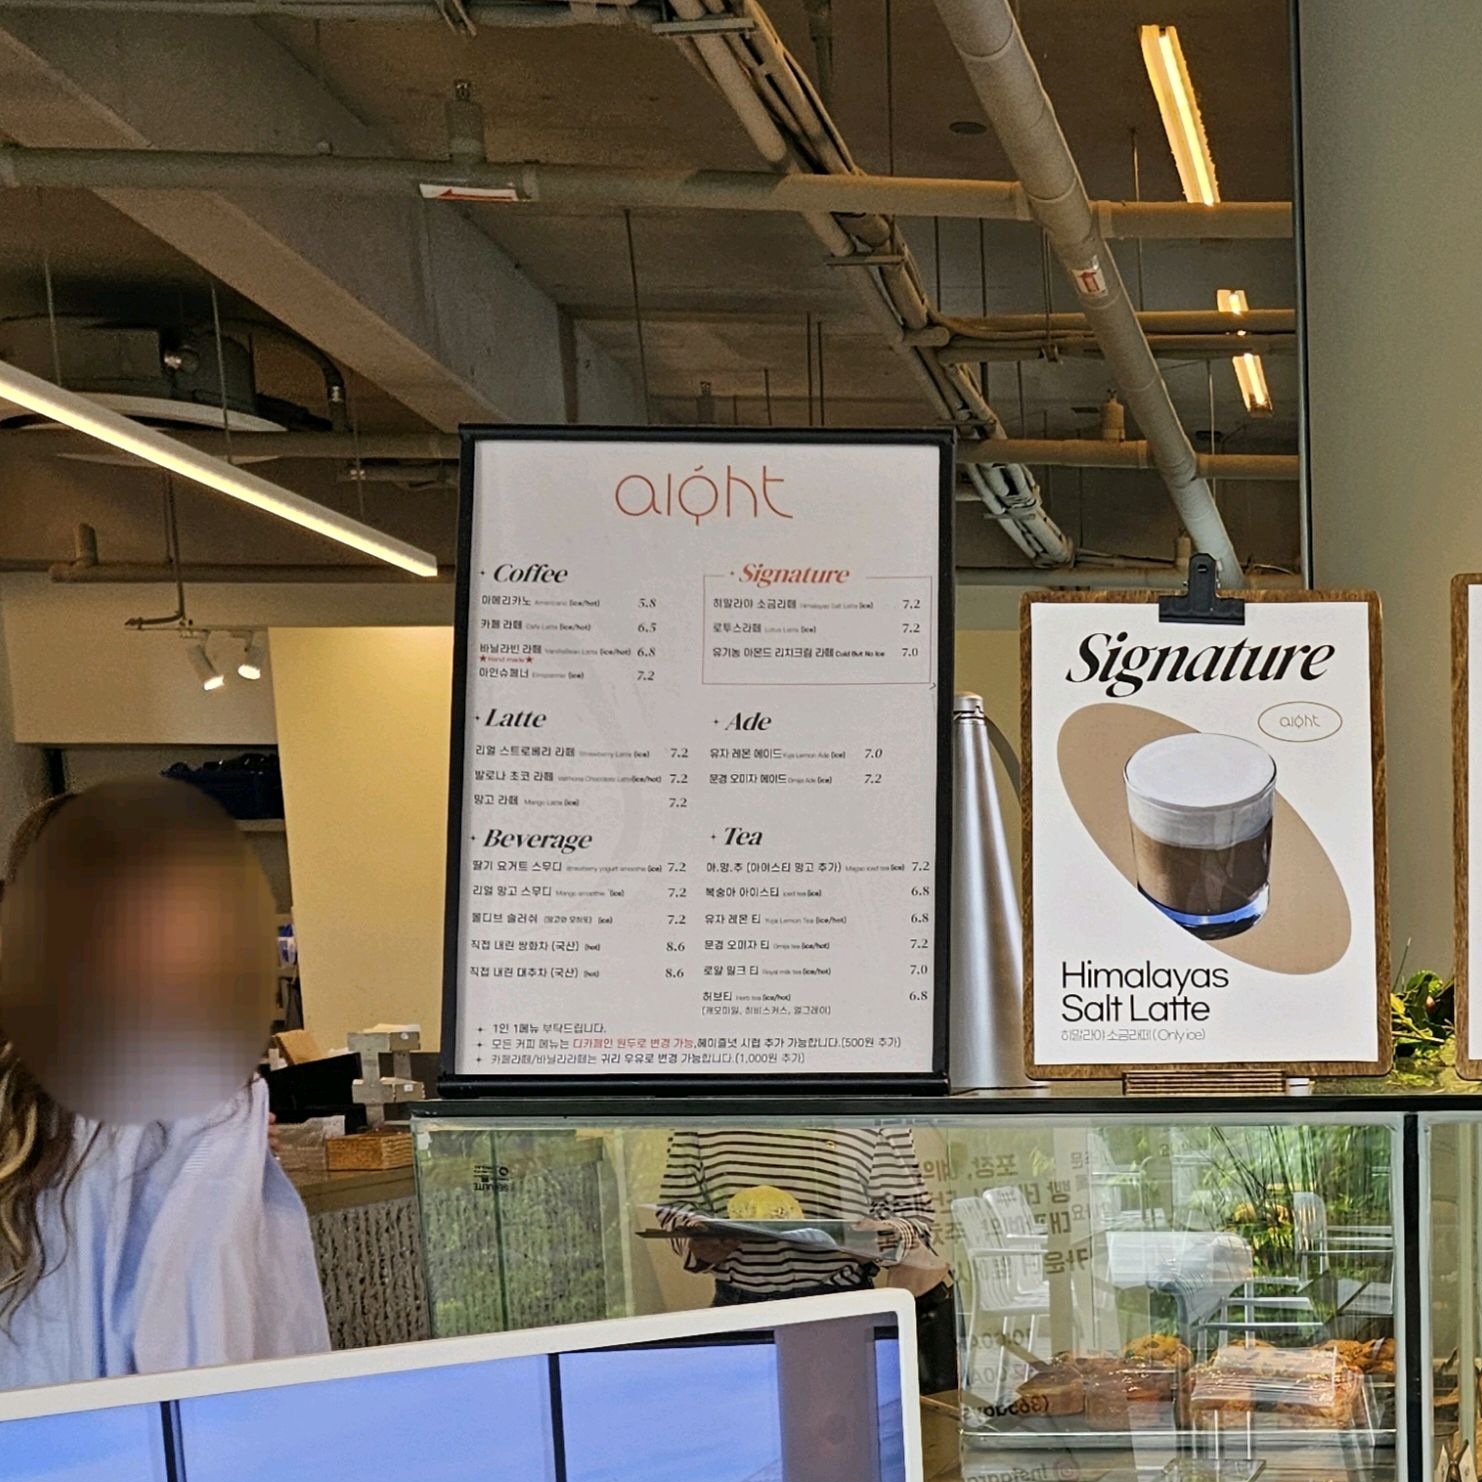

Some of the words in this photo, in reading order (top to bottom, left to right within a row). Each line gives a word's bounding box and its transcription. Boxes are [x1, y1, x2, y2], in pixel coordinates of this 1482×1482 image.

[493, 563, 569, 583] Coffee
[739, 562, 850, 588] Signature
[482, 595, 531, 606] 아메리카노
[638, 598, 657, 608] 5.8
[713, 598, 753, 609] 히말라야
[756, 599, 797, 609] 소금라떼
[902, 599, 921, 610] 7.2
[480, 619, 500, 630] 카페
[503, 620, 523, 630] 라떼
[638, 623, 657, 633] 6.5
[902, 623, 920, 633] 7.2
[480, 644, 520, 655] 바닐라빈
[522, 644, 542, 654] 라떼
[637, 647, 656, 657] 6.8
[713, 647, 741, 658] 유기농
[743, 648, 772, 658] 아몬드
[774, 648, 813, 658] 리치크림
[902, 648, 918, 657] 7.0
[1065, 631, 1335, 698] Signature
[479, 667, 529, 679] 아인슈페너
[637, 671, 655, 681] 7.2
[485, 708, 547, 728] Latte
[725, 712, 772, 731] Ade
[475, 746, 496, 756] 리얼
[500, 747, 551, 757] 스트로베리
[555, 747, 575, 757] 라떼
[670, 748, 689, 758] 7.2
[709, 748, 729, 759] 유자
[731, 748, 751, 759] 레몬
[753, 748, 782, 759] 에이드
[864, 748, 883, 758] 7.0
[475, 770, 506, 781] 발로나
[509, 771, 530, 781] 초코
[533, 771, 554, 782] 라떼
[669, 773, 688, 784] 7.2
[730, 774, 757, 784] 오미자
[760, 774, 786, 784] 에이드
[864, 774, 882, 784] 7.2
[474, 795, 494, 805] 망고
[498, 795, 518, 805] 라떼
[669, 797, 688, 808] 7.2
[482, 828, 593, 854] Beverage
[724, 827, 763, 846] Tea
[472, 860, 493, 871] 딸기
[497, 861, 528, 871] 요거트
[531, 861, 562, 872] 스무디
[667, 862, 686, 872] 7.2
[794, 862, 814, 872] 망고
[912, 861, 930, 871] 7.2
[472, 885, 493, 896] 리얼
[497, 886, 517, 896] 망고
[521, 886, 551, 897] 스무디
[668, 888, 687, 898] 7.2
[706, 887, 736, 897] 복숭아
[739, 887, 779, 897] 아이스티
[911, 886, 930, 896] 6.8
[472, 912, 503, 924] 몰디브
[507, 912, 538, 924] 슬러쉬
[667, 914, 686, 925] 7.2
[705, 914, 725, 925] 유자
[728, 914, 749, 925] 레몬
[752, 914, 761, 924] 티
[911, 913, 929, 924] 6.8
[471, 940, 490, 950] 직접
[494, 940, 515, 950] 내린
[518, 940, 549, 951] 쌍화차
[551, 940, 580, 952] (국산)
[666, 941, 685, 952] 8.6
[727, 940, 757, 950] 오미자
[760, 940, 769, 950] 티
[910, 939, 929, 949] 7.2
[469, 967, 490, 978] 직접
[493, 967, 513, 978] 내린
[517, 967, 547, 978] 대추차
[550, 967, 578, 979] (국산)
[665, 967, 685, 978] 8.6
[726, 966, 746, 976] 밀크
[750, 966, 759, 976] 티
[909, 964, 928, 975] 7.0
[1061, 960, 1229, 999] Himalayas
[703, 991, 732, 1001] 허브티
[909, 991, 928, 1001] 6.8
[1061, 993, 1123, 1023] Salt
[1130, 993, 1210, 1022] Latte
[493, 1024, 509, 1034] 1인
[513, 1024, 539, 1034] 1메뉴
[542, 1024, 607, 1034] 부탁드립니다.
[1061, 1029, 1105, 1041] 히말라야
[491, 1039, 512, 1050] 모든
[515, 1039, 535, 1049] 커피
[538, 1039, 569, 1049] 메뉴는
[573, 1039, 614, 1049] 디카페인
[617, 1039, 646, 1049] 원두로
[650, 1038, 671, 1049] 변경
[741, 1038, 761, 1048] 시럽
[764, 1038, 784, 1048] 추가
[601, 1054, 620, 1064] 귀리
[624, 1054, 654, 1064] 우유로
[658, 1054, 678, 1064] 변경
